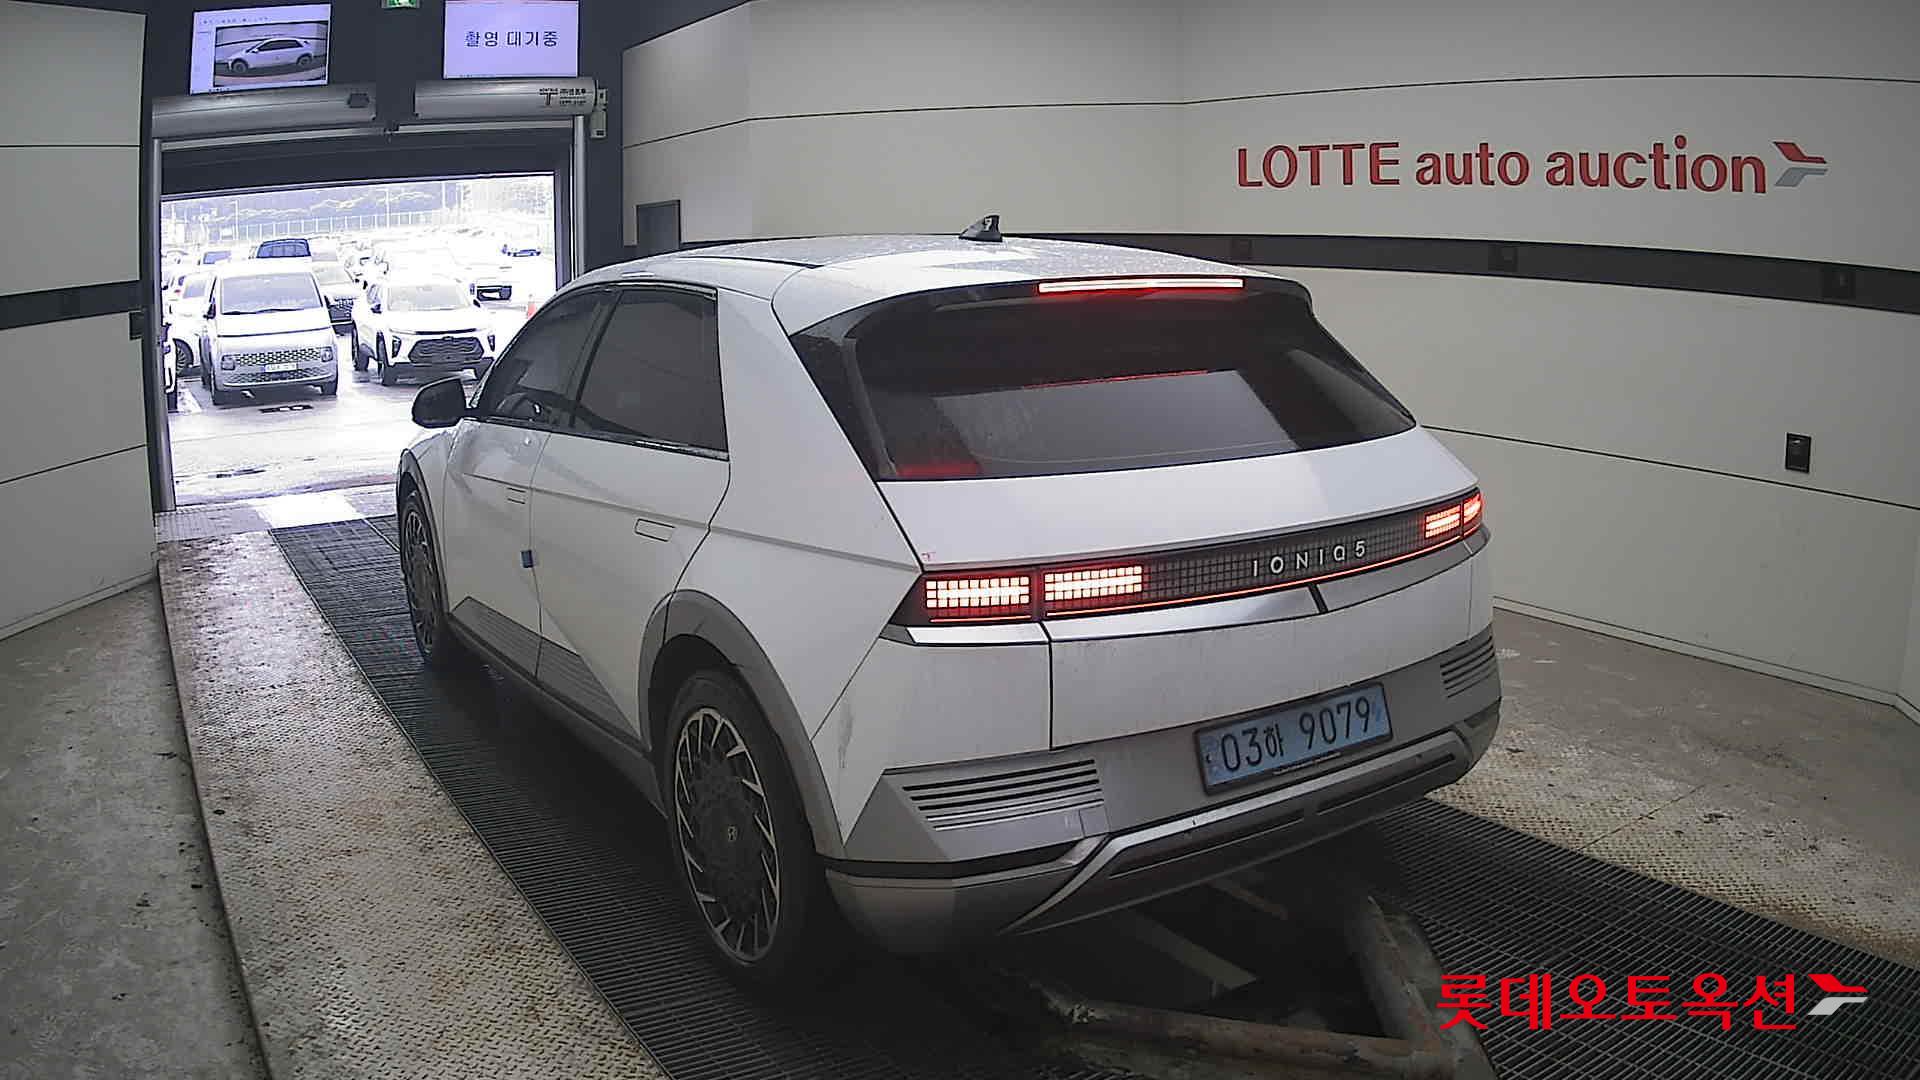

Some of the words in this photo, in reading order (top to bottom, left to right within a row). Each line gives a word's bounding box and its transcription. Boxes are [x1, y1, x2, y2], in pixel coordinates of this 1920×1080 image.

[465, 30, 498, 47] 촬영
[507, 30, 559, 47] 대기중
[1237, 141, 1400, 188] LOTTE
[1416, 141, 1530, 187] auto
[1545, 135, 1767, 194] auction
[1221, 722, 1284, 771] 03하
[1298, 695, 1371, 751] 9079
